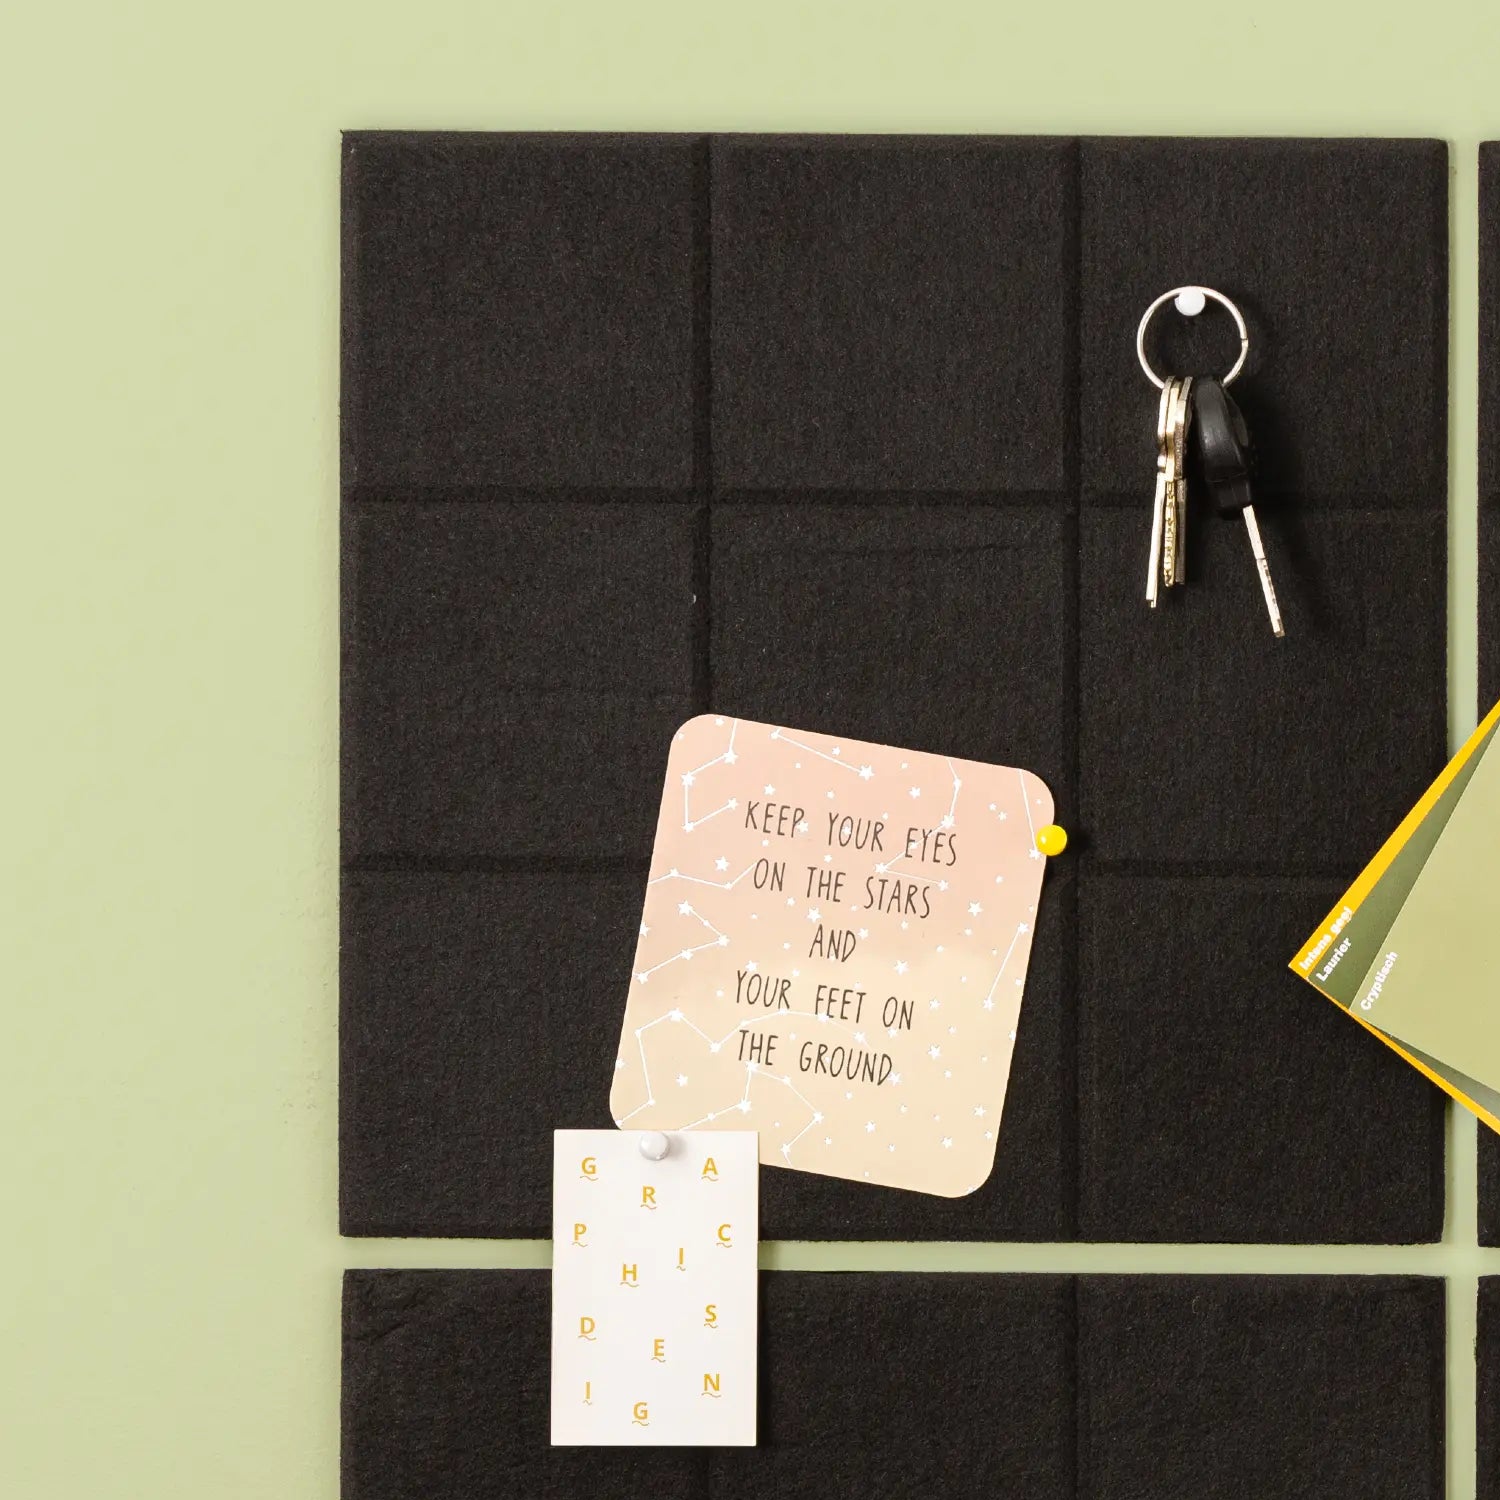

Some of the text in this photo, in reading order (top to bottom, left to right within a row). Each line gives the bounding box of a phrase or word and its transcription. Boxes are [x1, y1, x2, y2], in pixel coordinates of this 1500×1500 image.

[745, 801, 957, 866] KEEP YOUR EYES
[753, 858, 931, 919] ON THE STARS
[809, 924, 857, 963] AND
[1316, 937, 1352, 982] Laurier
[736, 970, 914, 1031] YOUR FEET ON
[1360, 951, 1398, 1011] Cryptisch
[739, 1030, 893, 1086] THE GROUND
